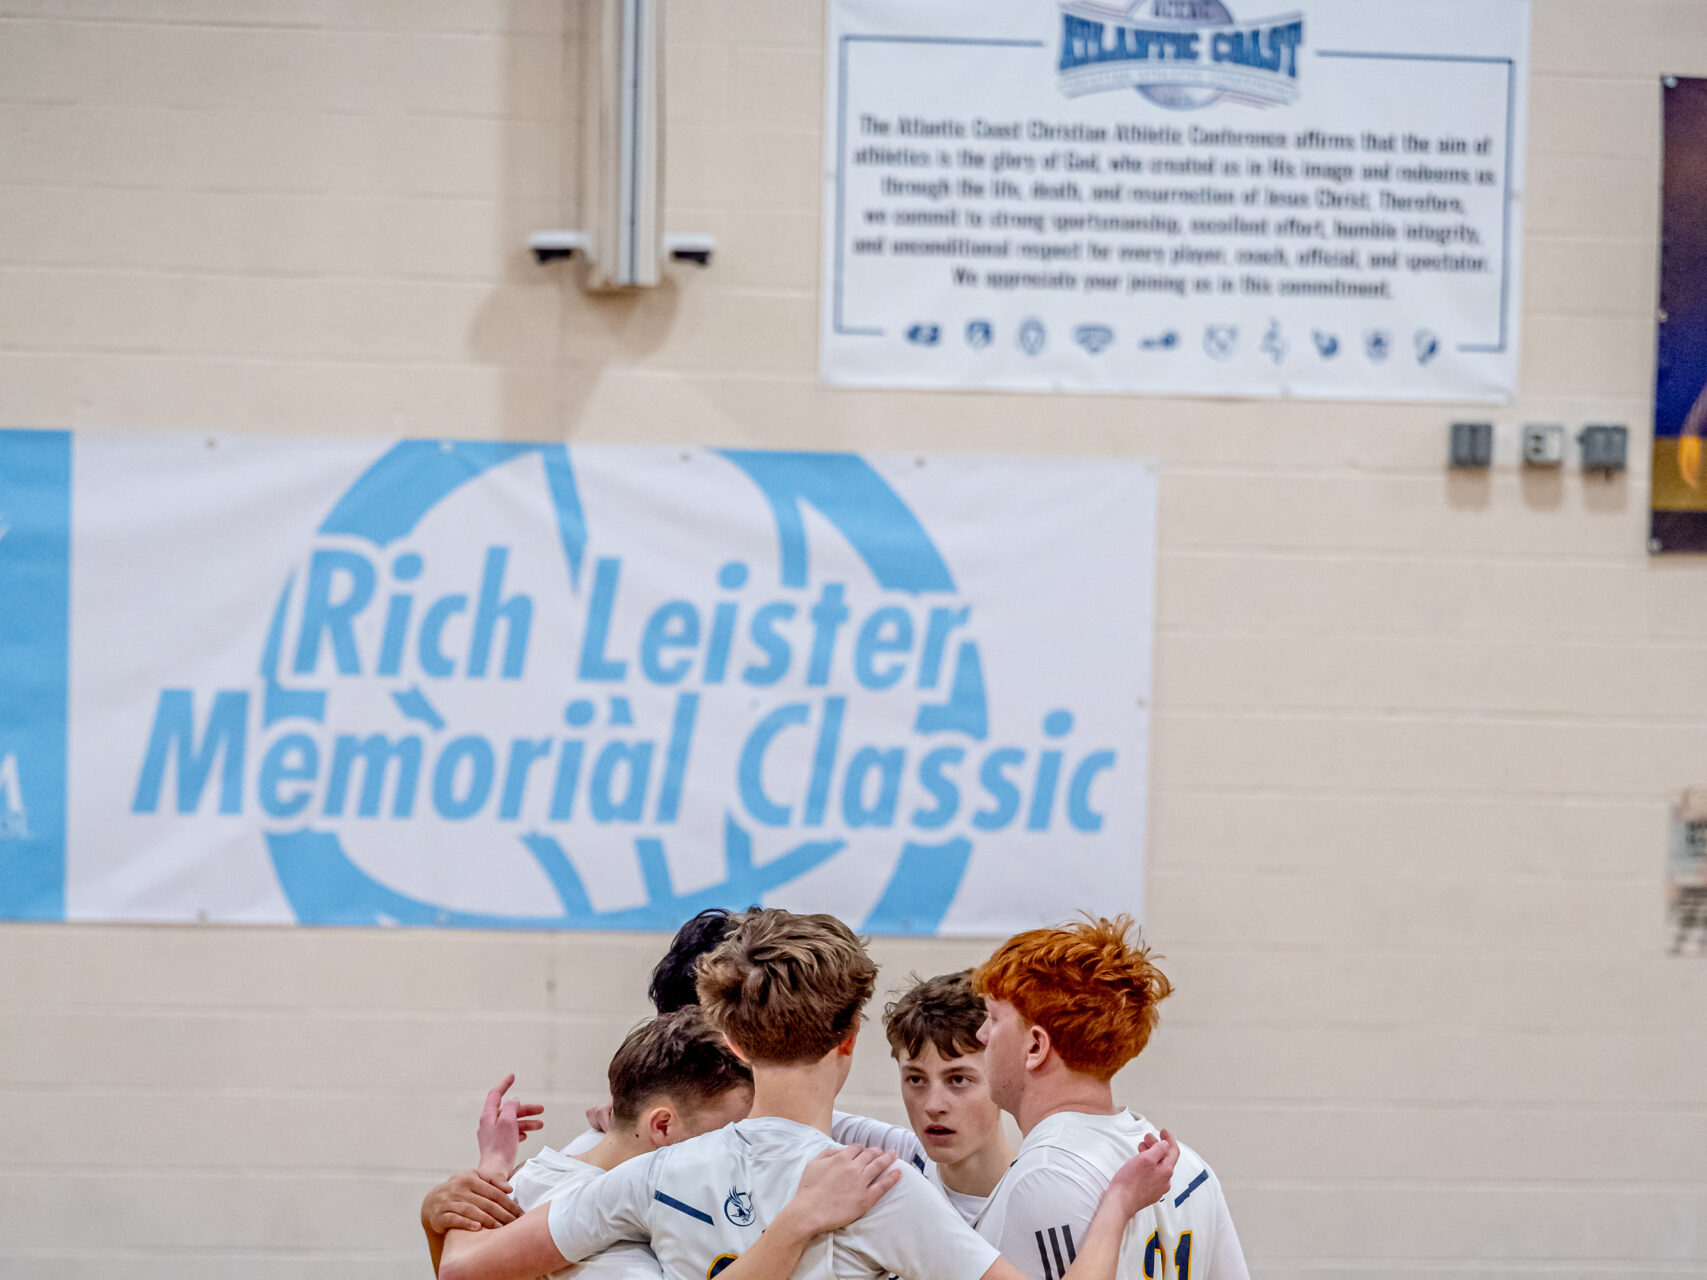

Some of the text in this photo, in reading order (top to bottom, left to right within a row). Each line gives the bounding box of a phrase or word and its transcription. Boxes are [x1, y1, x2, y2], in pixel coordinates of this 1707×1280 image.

[1060, 14, 1302, 78] ATLANTIC COAST
[861, 115, 1492, 154] The Atlantic Coast Christian Athletic Conference affirms that the aim of
[854, 147, 931, 166] athletics
[936, 151, 952, 167] is
[957, 150, 986, 168] the
[990, 152, 1036, 173] glory
[1041, 153, 1060, 170] of
[1109, 156, 1144, 172] who
[1148, 157, 1217, 175] created
[1219, 161, 1241, 176] us
[1246, 162, 1264, 176] in
[1267, 159, 1296, 176] His
[1301, 164, 1354, 183] image
[1361, 164, 1392, 180] and
[1475, 171, 1496, 184] us
[882, 177, 952, 199] through
[956, 179, 985, 197] the
[1091, 184, 1124, 202] and
[1127, 186, 1236, 205] resurrection
[1241, 188, 1260, 205] of
[1264, 190, 1310, 207] Jesus
[863, 211, 888, 224] we
[893, 209, 960, 227] commit
[965, 212, 984, 227] to
[989, 212, 1047, 232] strong
[854, 238, 886, 254] and
[890, 238, 1012, 257] unconditional
[1016, 242, 1083, 261] respect
[1087, 243, 1112, 260] for
[1117, 247, 1166, 263] every
[1368, 253, 1400, 269] and
[952, 268, 979, 285] We
[985, 271, 1078, 291] appreciate
[1083, 275, 1121, 292] your
[1126, 275, 1188, 295] joining
[1191, 278, 1213, 293] us
[1217, 278, 1235, 292] in
[1240, 276, 1273, 293] this
[293, 547, 971, 690] Rich Leister
[131, 688, 1116, 834] Memorial Classic
